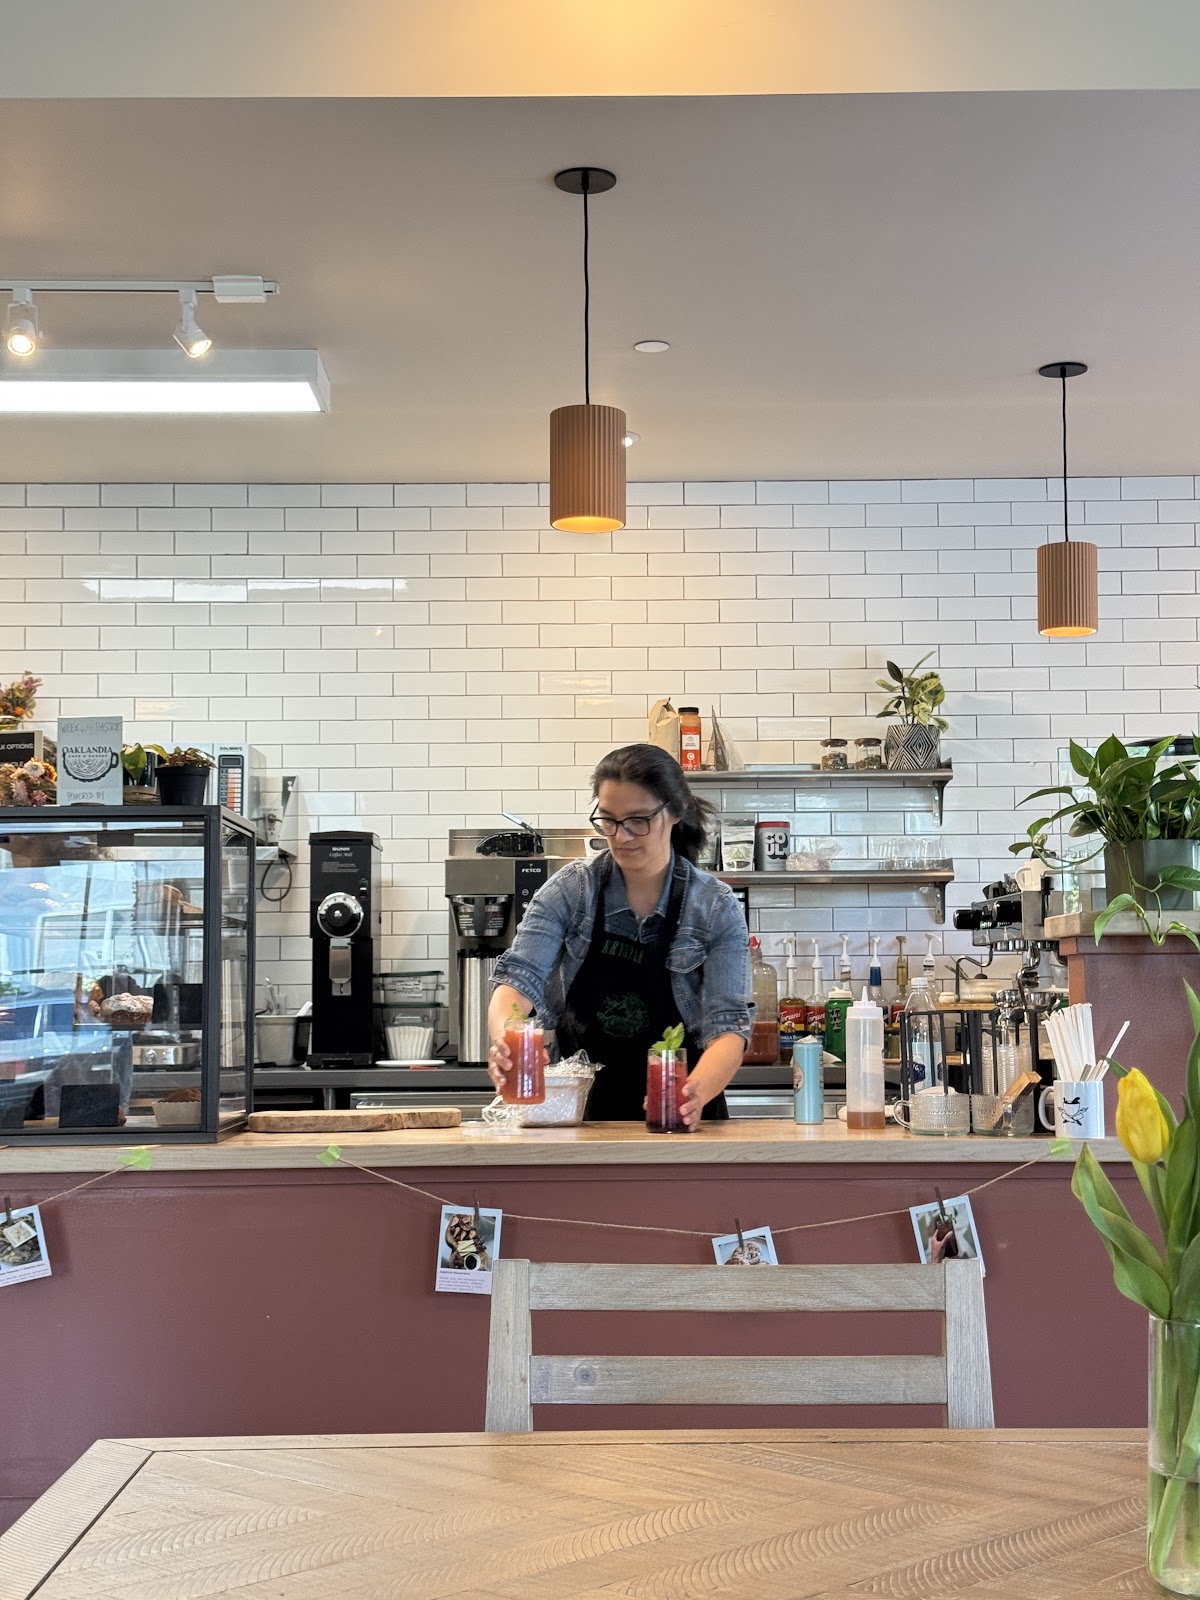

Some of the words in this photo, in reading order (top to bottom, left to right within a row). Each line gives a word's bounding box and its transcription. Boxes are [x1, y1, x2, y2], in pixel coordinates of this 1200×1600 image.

[764, 832, 788, 844] SO
[765, 843, 784, 855] UL
[779, 1010, 801, 1023] Torani
[805, 1010, 825, 1023] Toran
